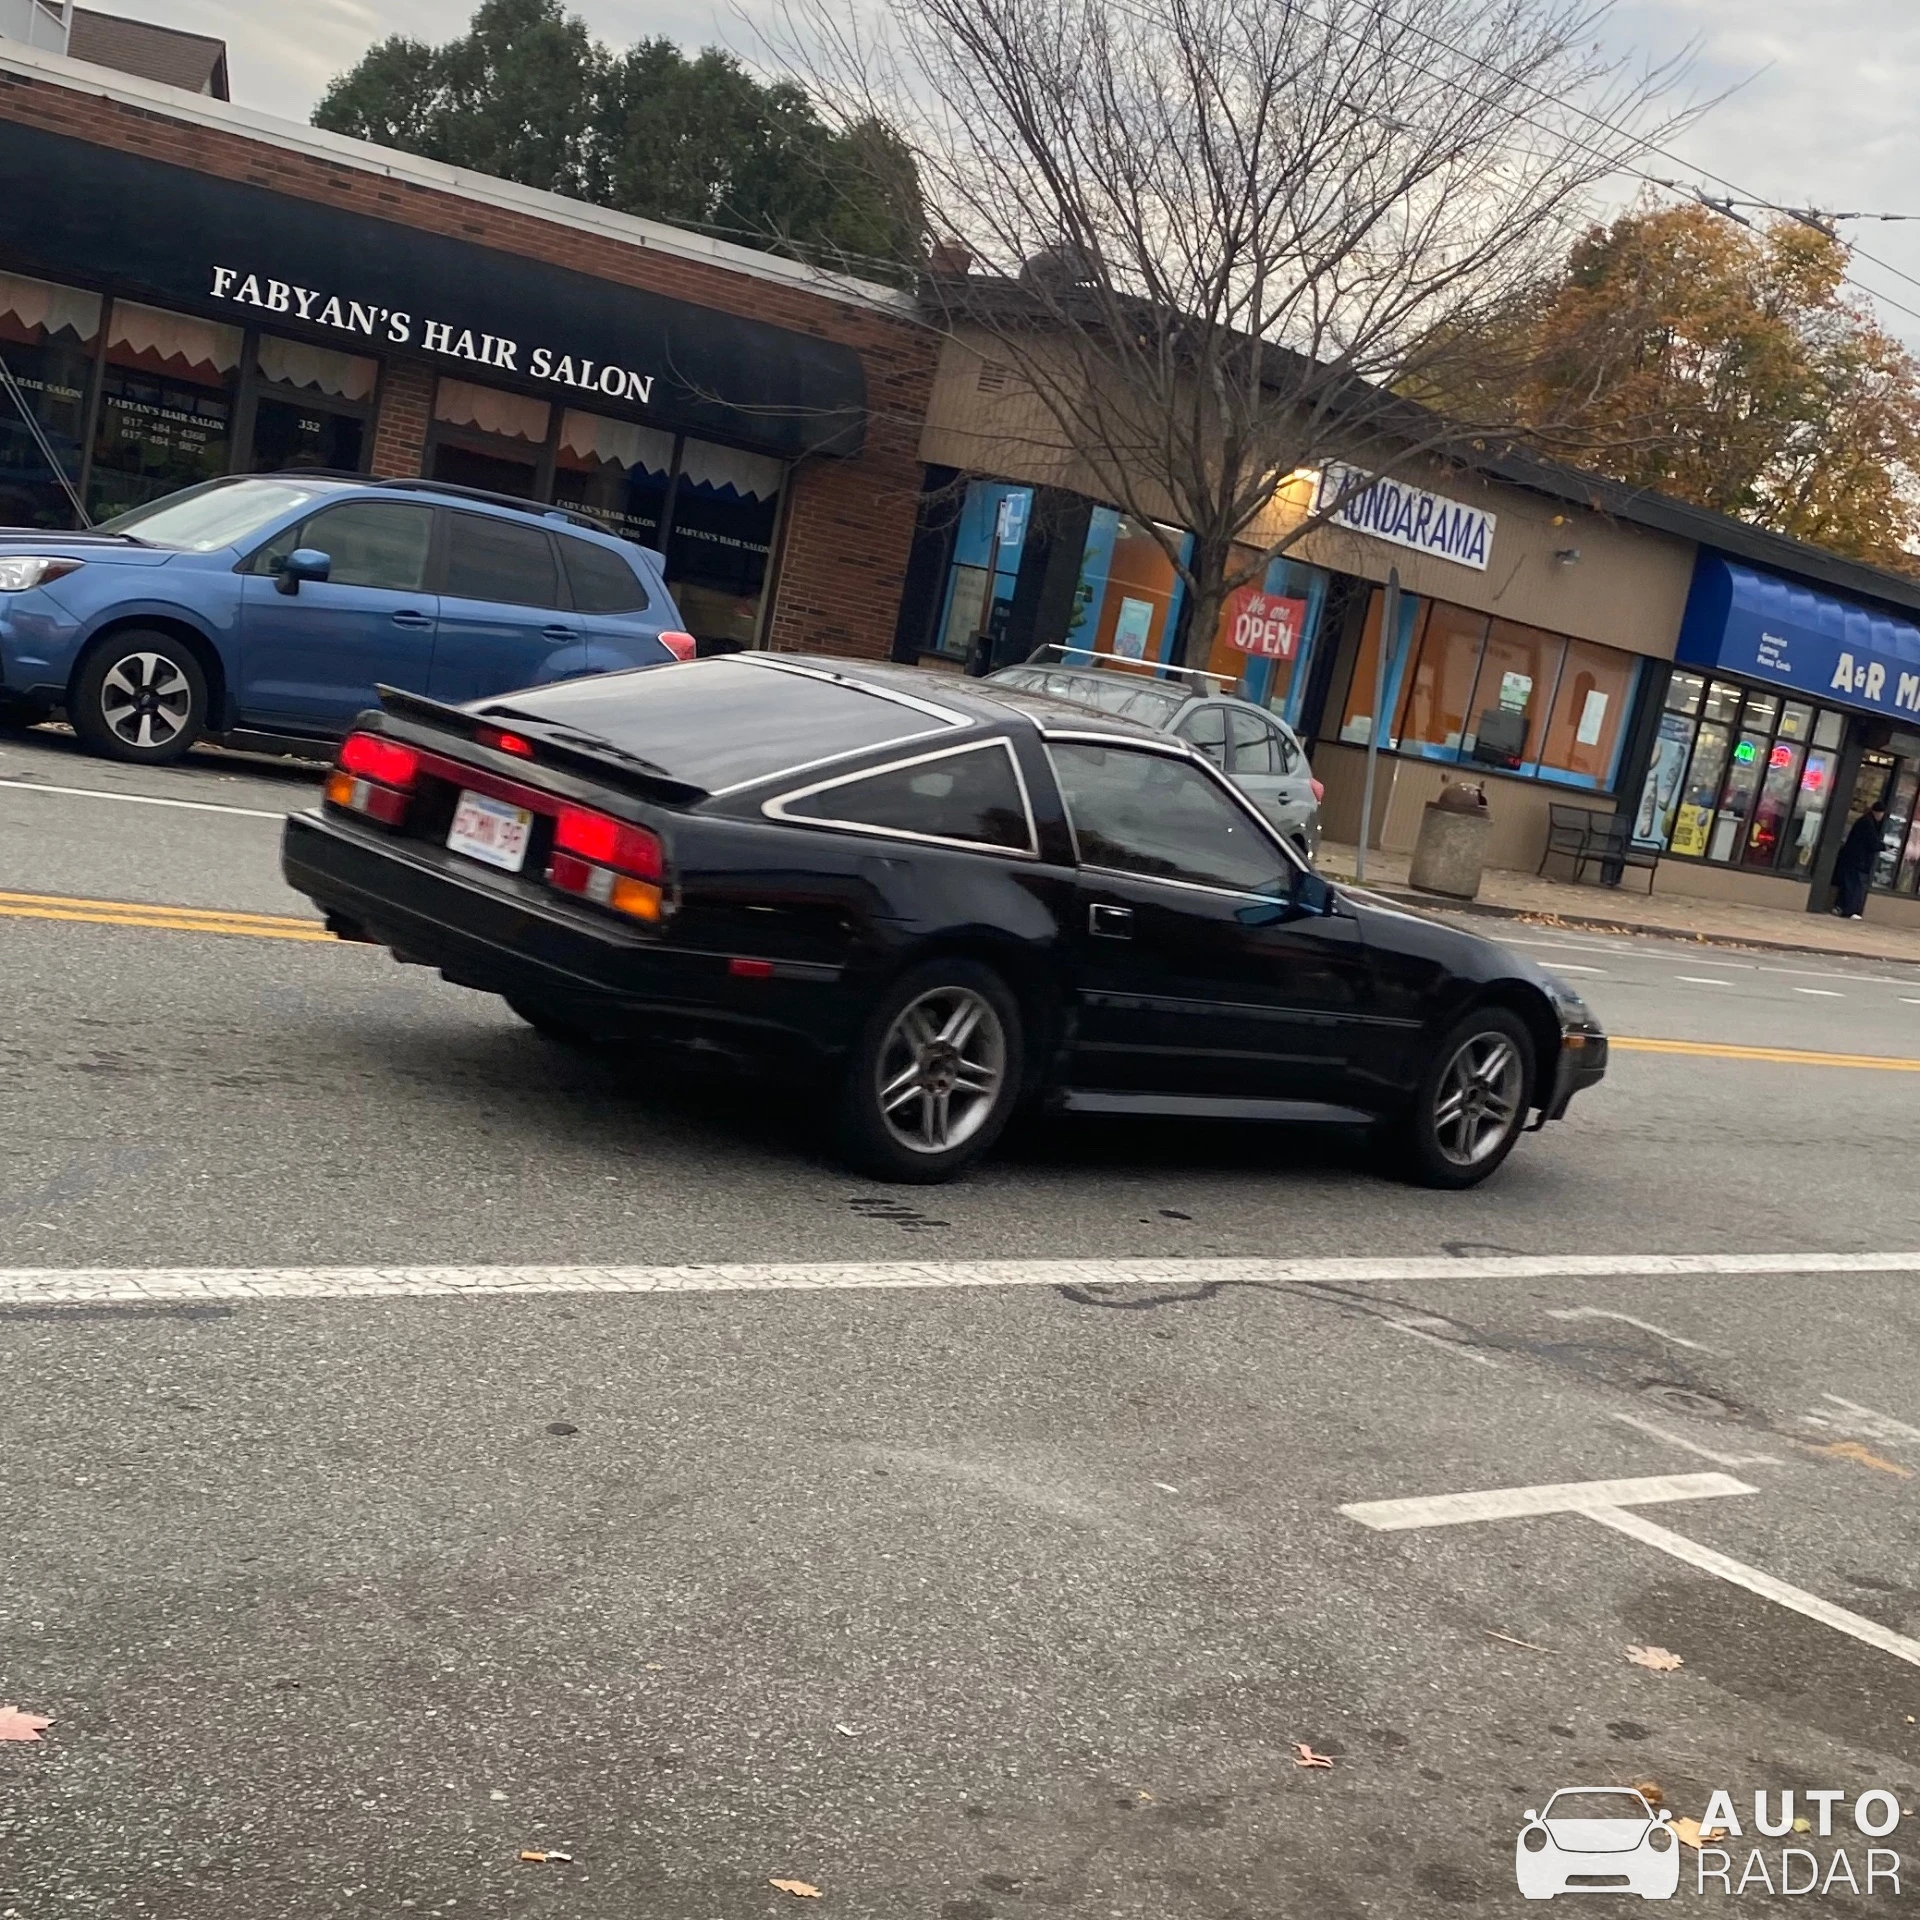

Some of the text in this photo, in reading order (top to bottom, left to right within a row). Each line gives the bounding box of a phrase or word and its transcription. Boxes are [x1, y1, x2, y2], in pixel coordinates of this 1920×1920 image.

[209, 265, 655, 404] FABYAN'S HAIR SALON
[16, 376, 44, 391] HAIR
[46, 383, 83, 399] SALON
[160, 409, 188, 422] HAIR
[189, 415, 224, 430] SALON
[298, 419, 320, 433] 352
[601, 508, 625, 521] HAIR
[627, 515, 657, 528] SALON
[719, 535, 741, 548] HAIR
[742, 542, 770, 554] SALON
[1247, 594, 1266, 616] We
[1235, 613, 1293, 655] OPEN
[1830, 652, 1886, 702] A&R
